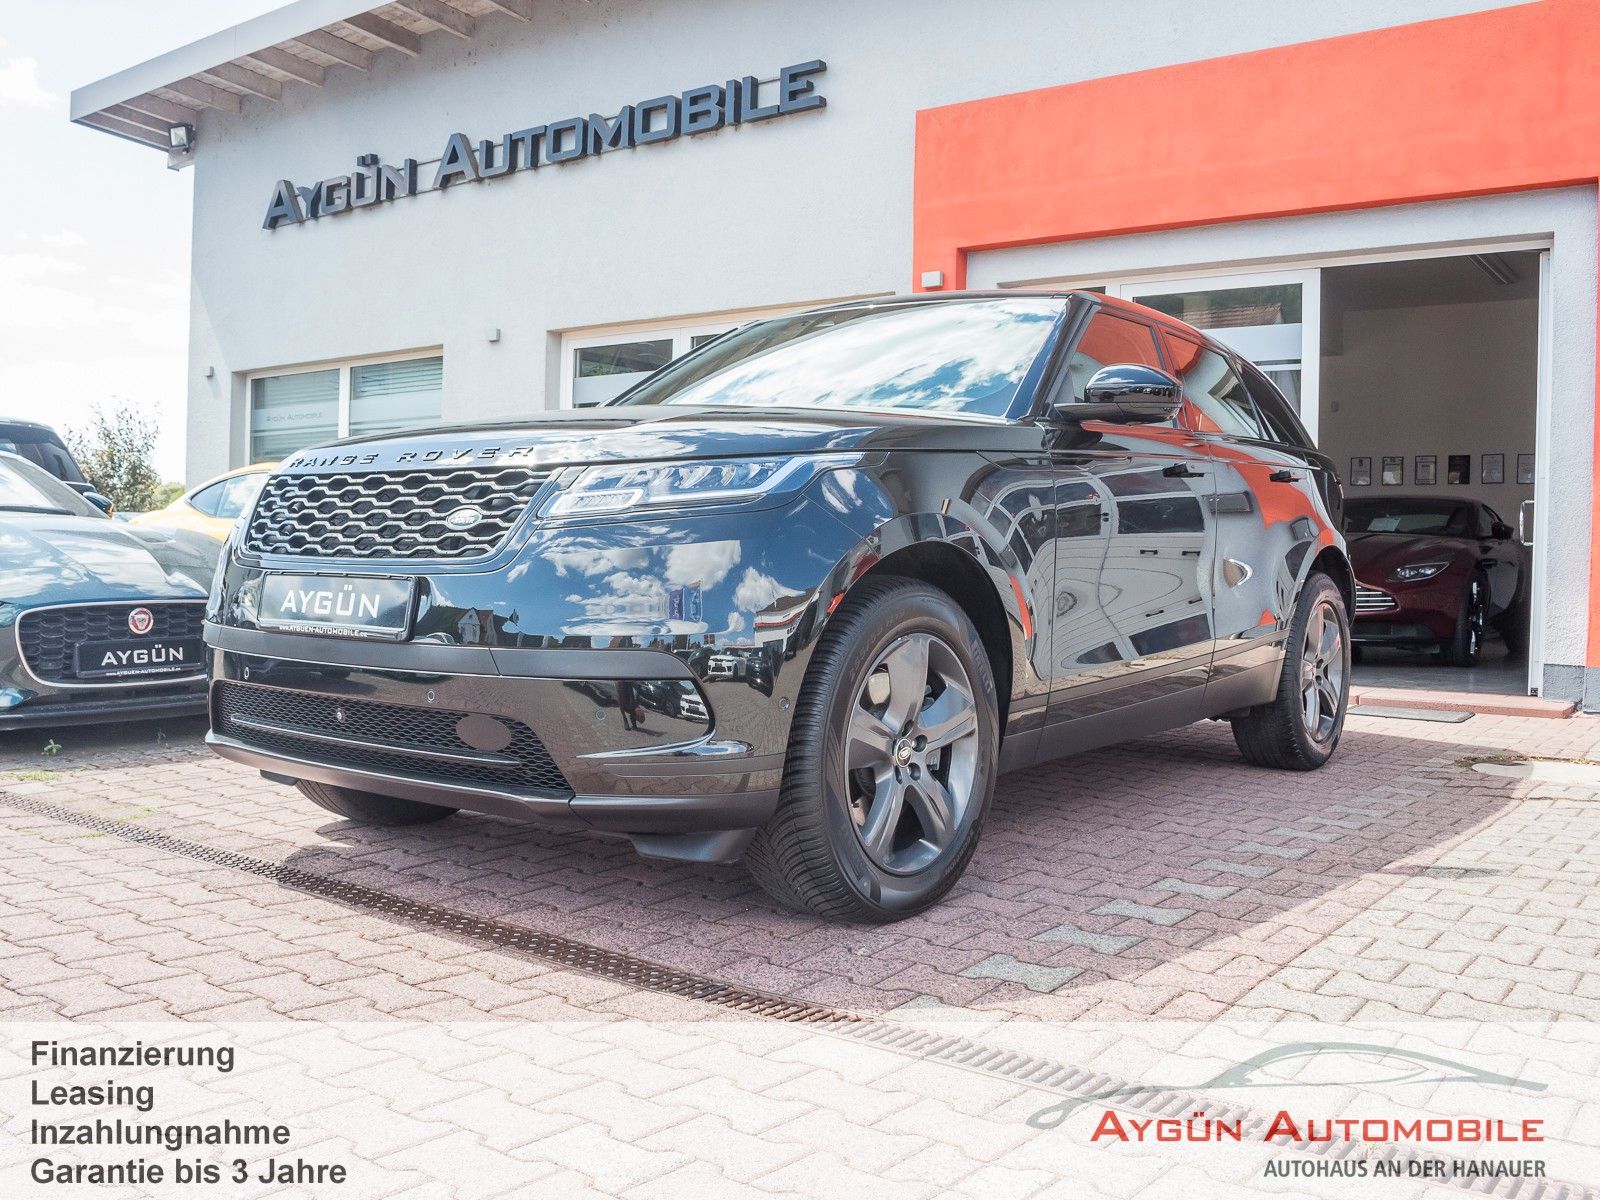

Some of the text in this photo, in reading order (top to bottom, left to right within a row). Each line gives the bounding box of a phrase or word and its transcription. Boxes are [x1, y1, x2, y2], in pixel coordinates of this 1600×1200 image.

[262, 59, 827, 230] AYGÜN AUTOMOBILE
[289, 446, 536, 468] RANGE ROVER
[280, 585, 380, 618] AYGÜN
[101, 644, 184, 666] AYGÜN
